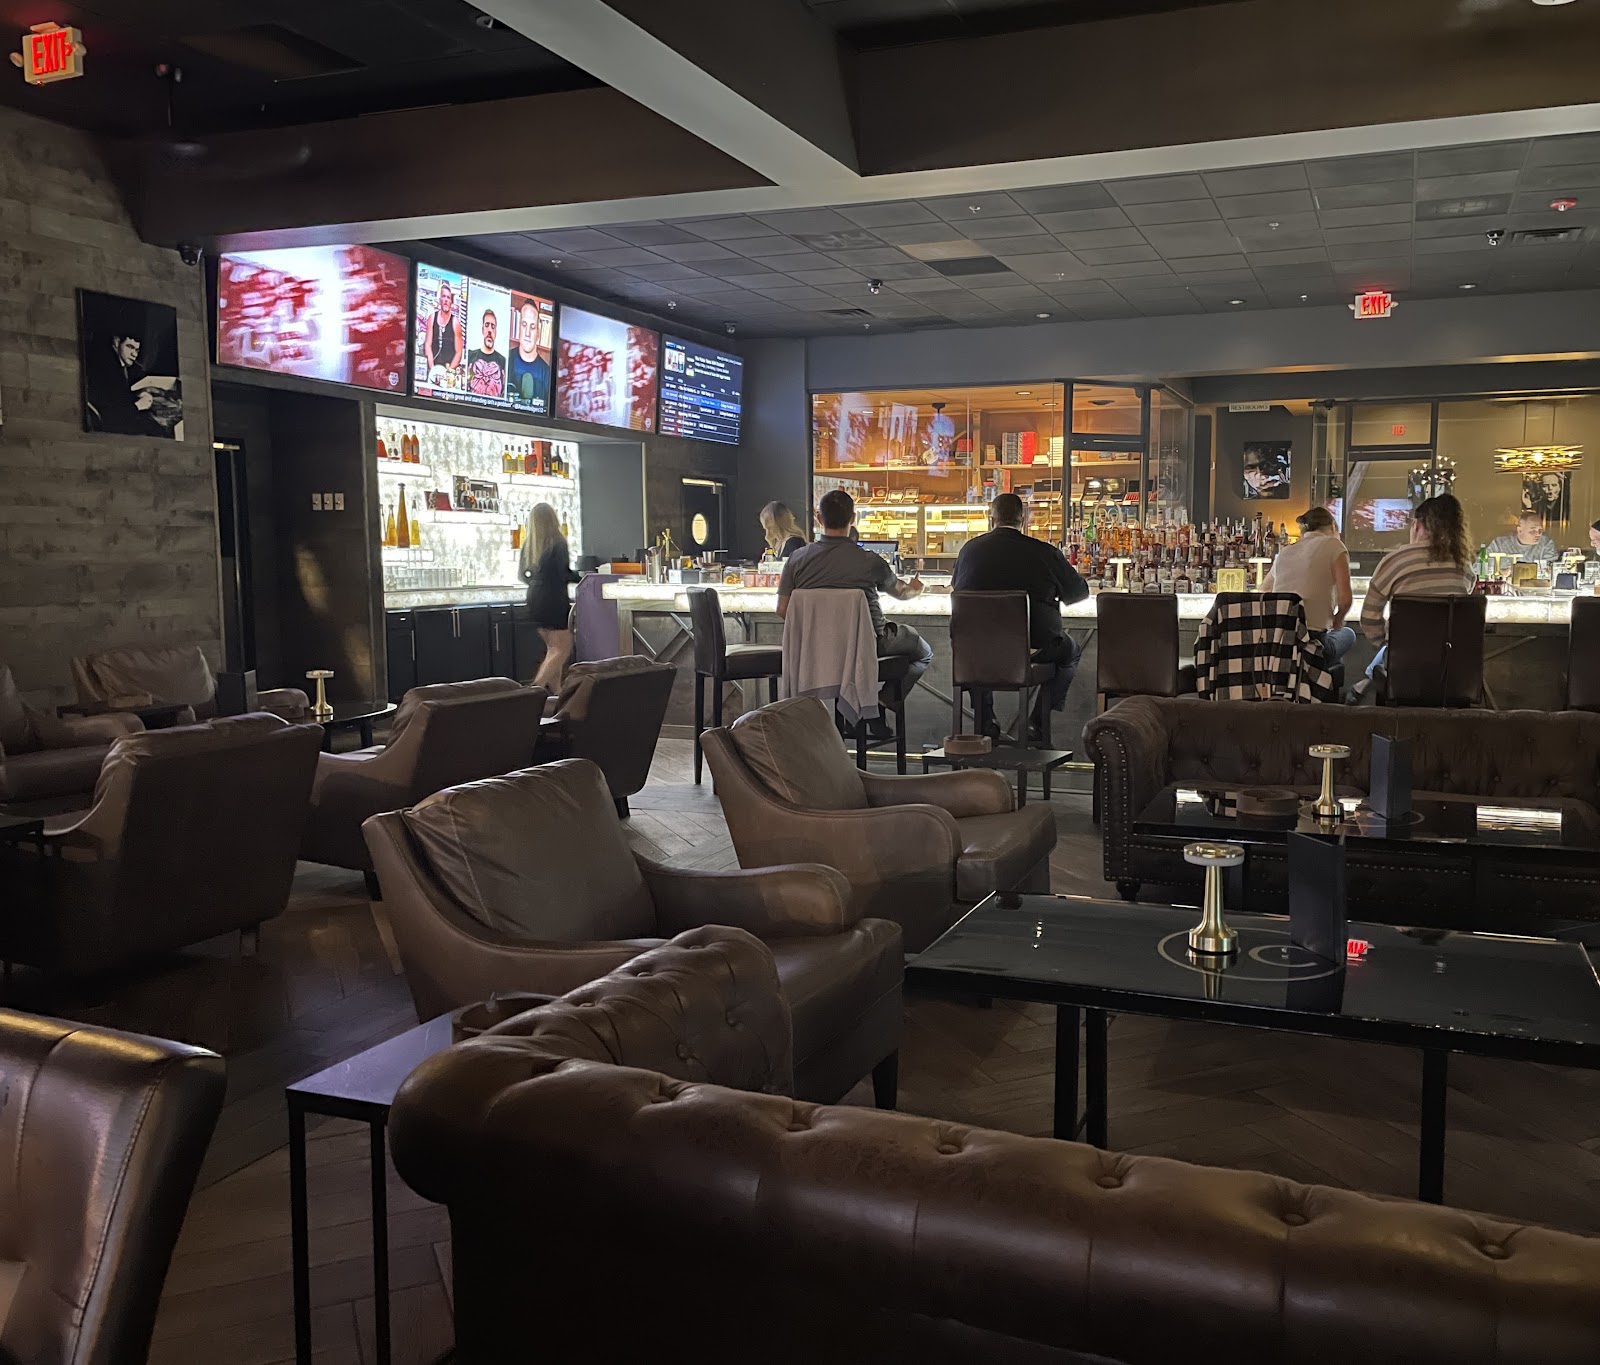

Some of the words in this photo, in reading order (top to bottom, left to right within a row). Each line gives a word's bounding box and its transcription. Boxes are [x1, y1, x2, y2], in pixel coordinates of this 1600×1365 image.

[32, 30, 67, 75] EXIT
[1361, 295, 1387, 315] EXIT
[455, 392, 464, 401] great
[472, 395, 487, 405] standing
